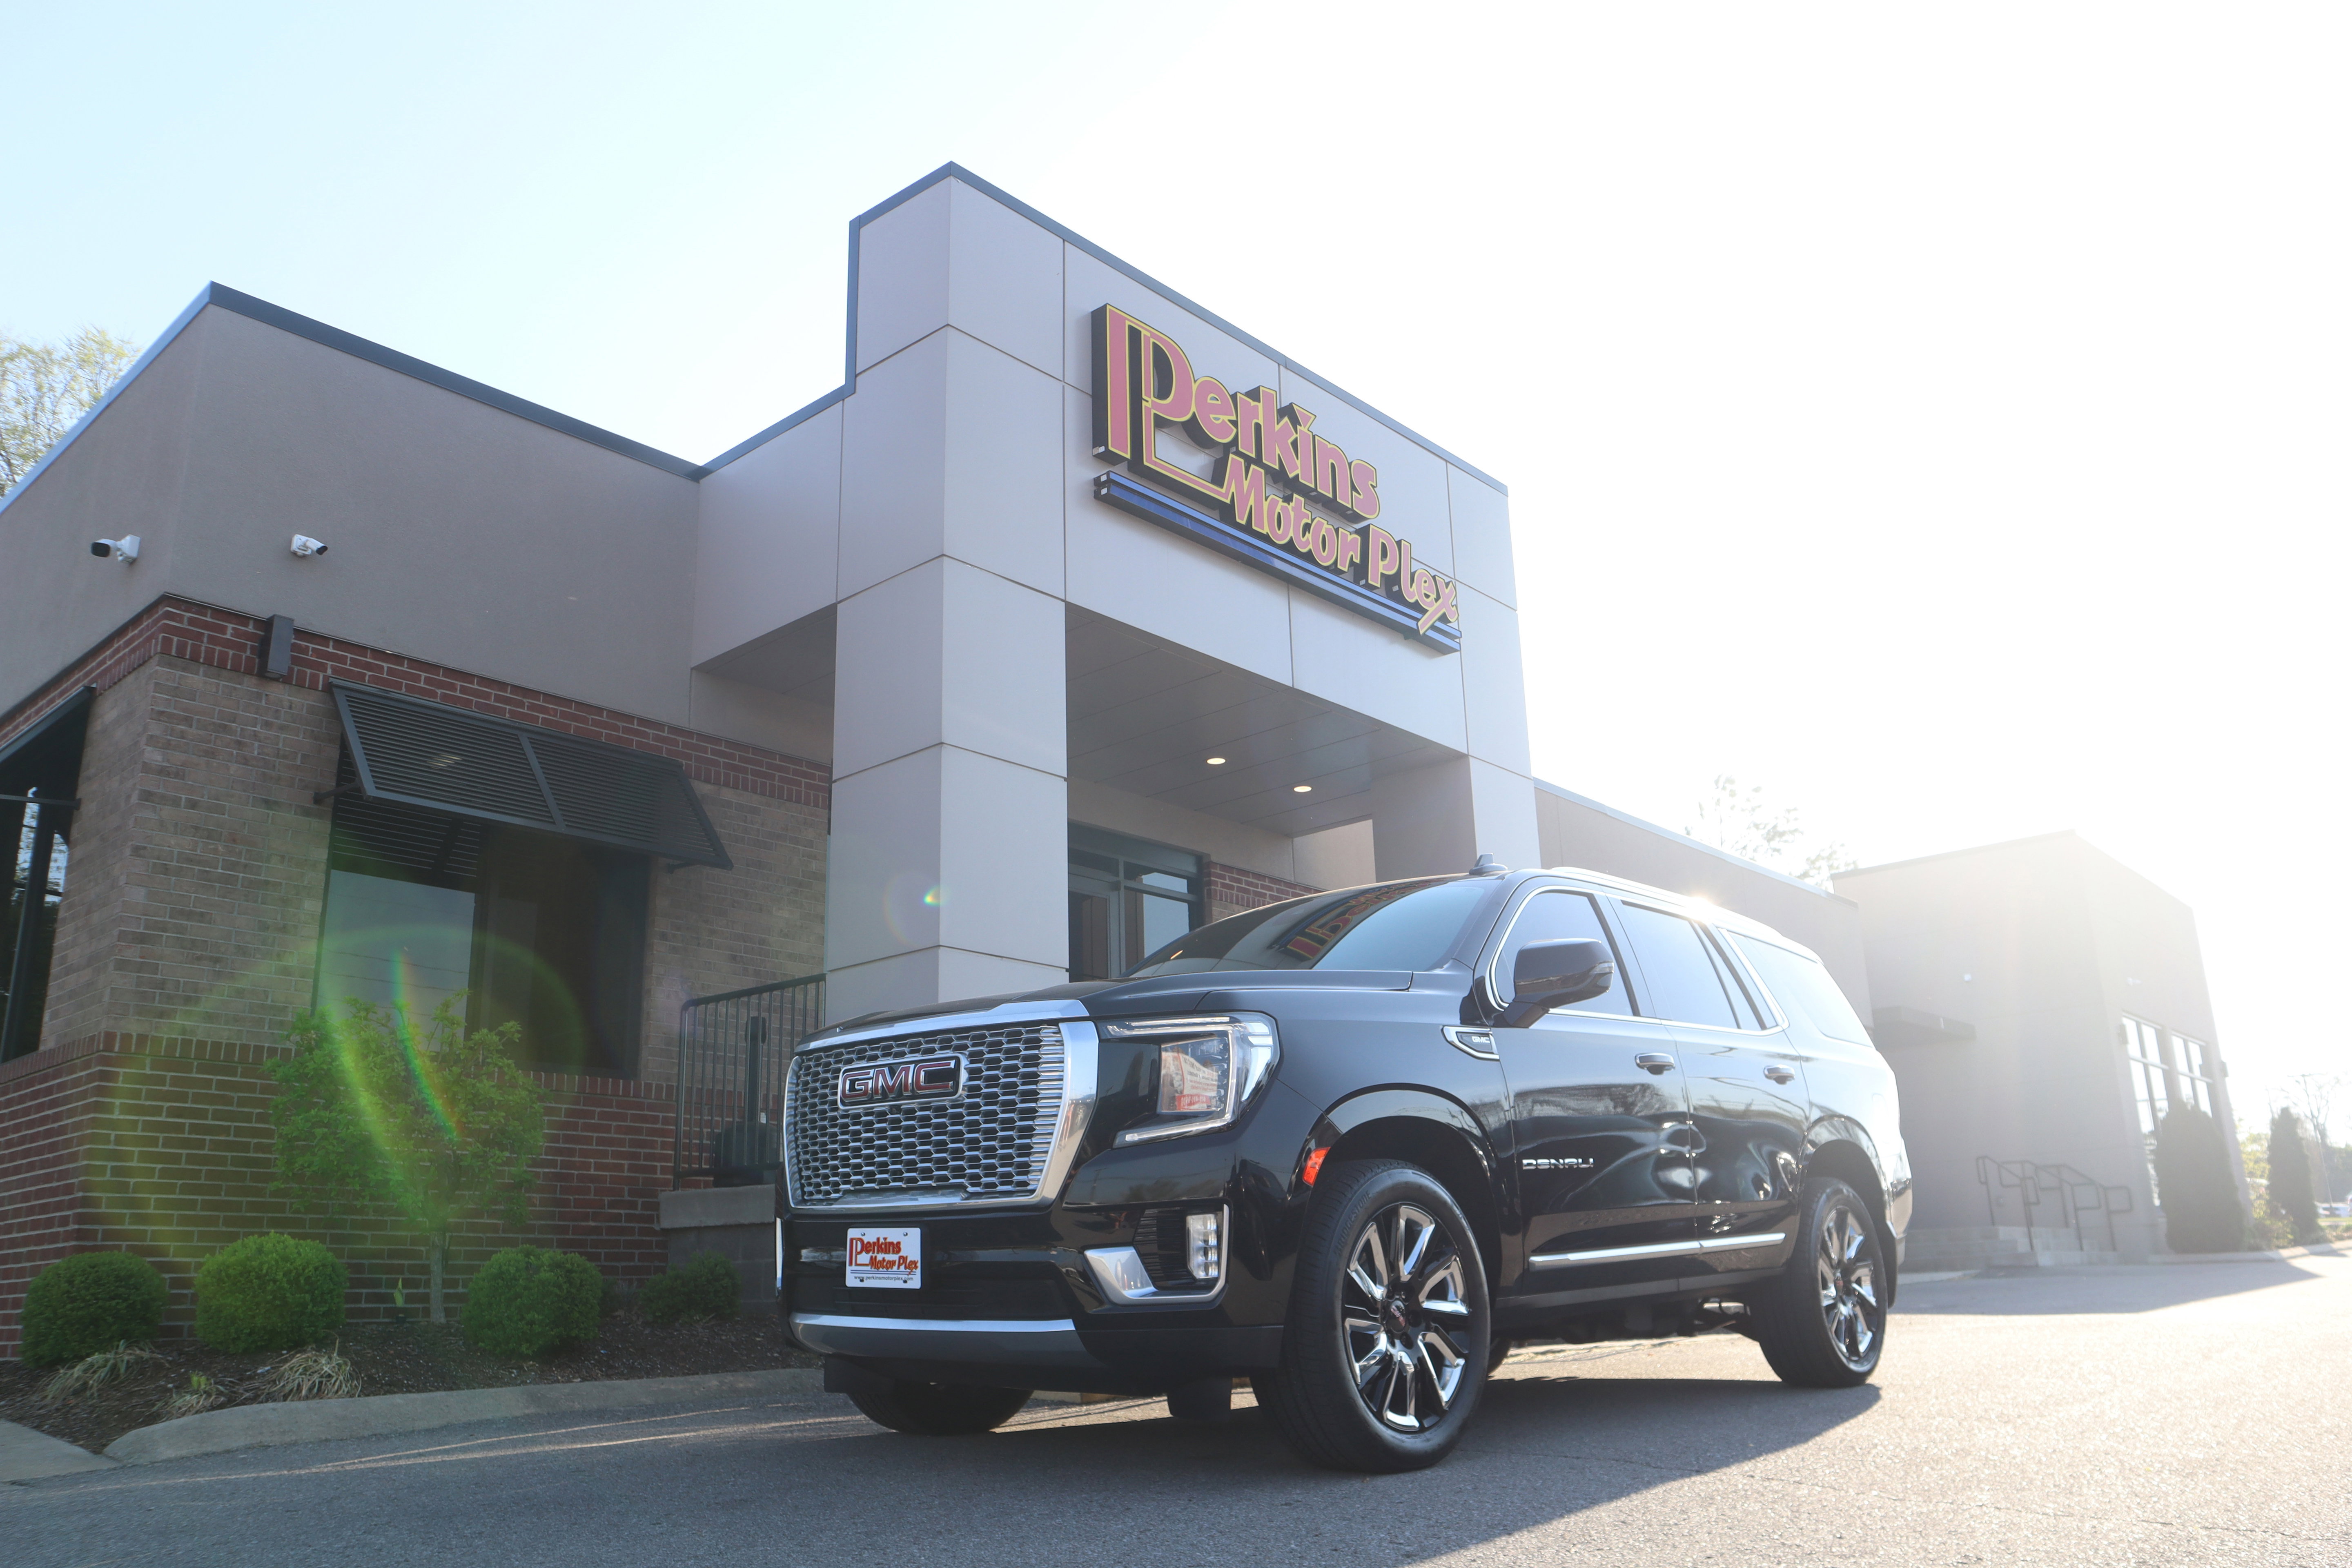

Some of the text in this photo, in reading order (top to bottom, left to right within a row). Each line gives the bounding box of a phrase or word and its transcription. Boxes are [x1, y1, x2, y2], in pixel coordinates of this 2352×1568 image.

[1106, 303, 1380, 519] Perkins
[1225, 452, 1459, 635] Motor Plex
[841, 1060, 956, 1102] GMC
[1522, 1158, 1594, 1170] DENALI
[849, 1237, 902, 1266] Perkins
[870, 1255, 919, 1276] Motor Plex
